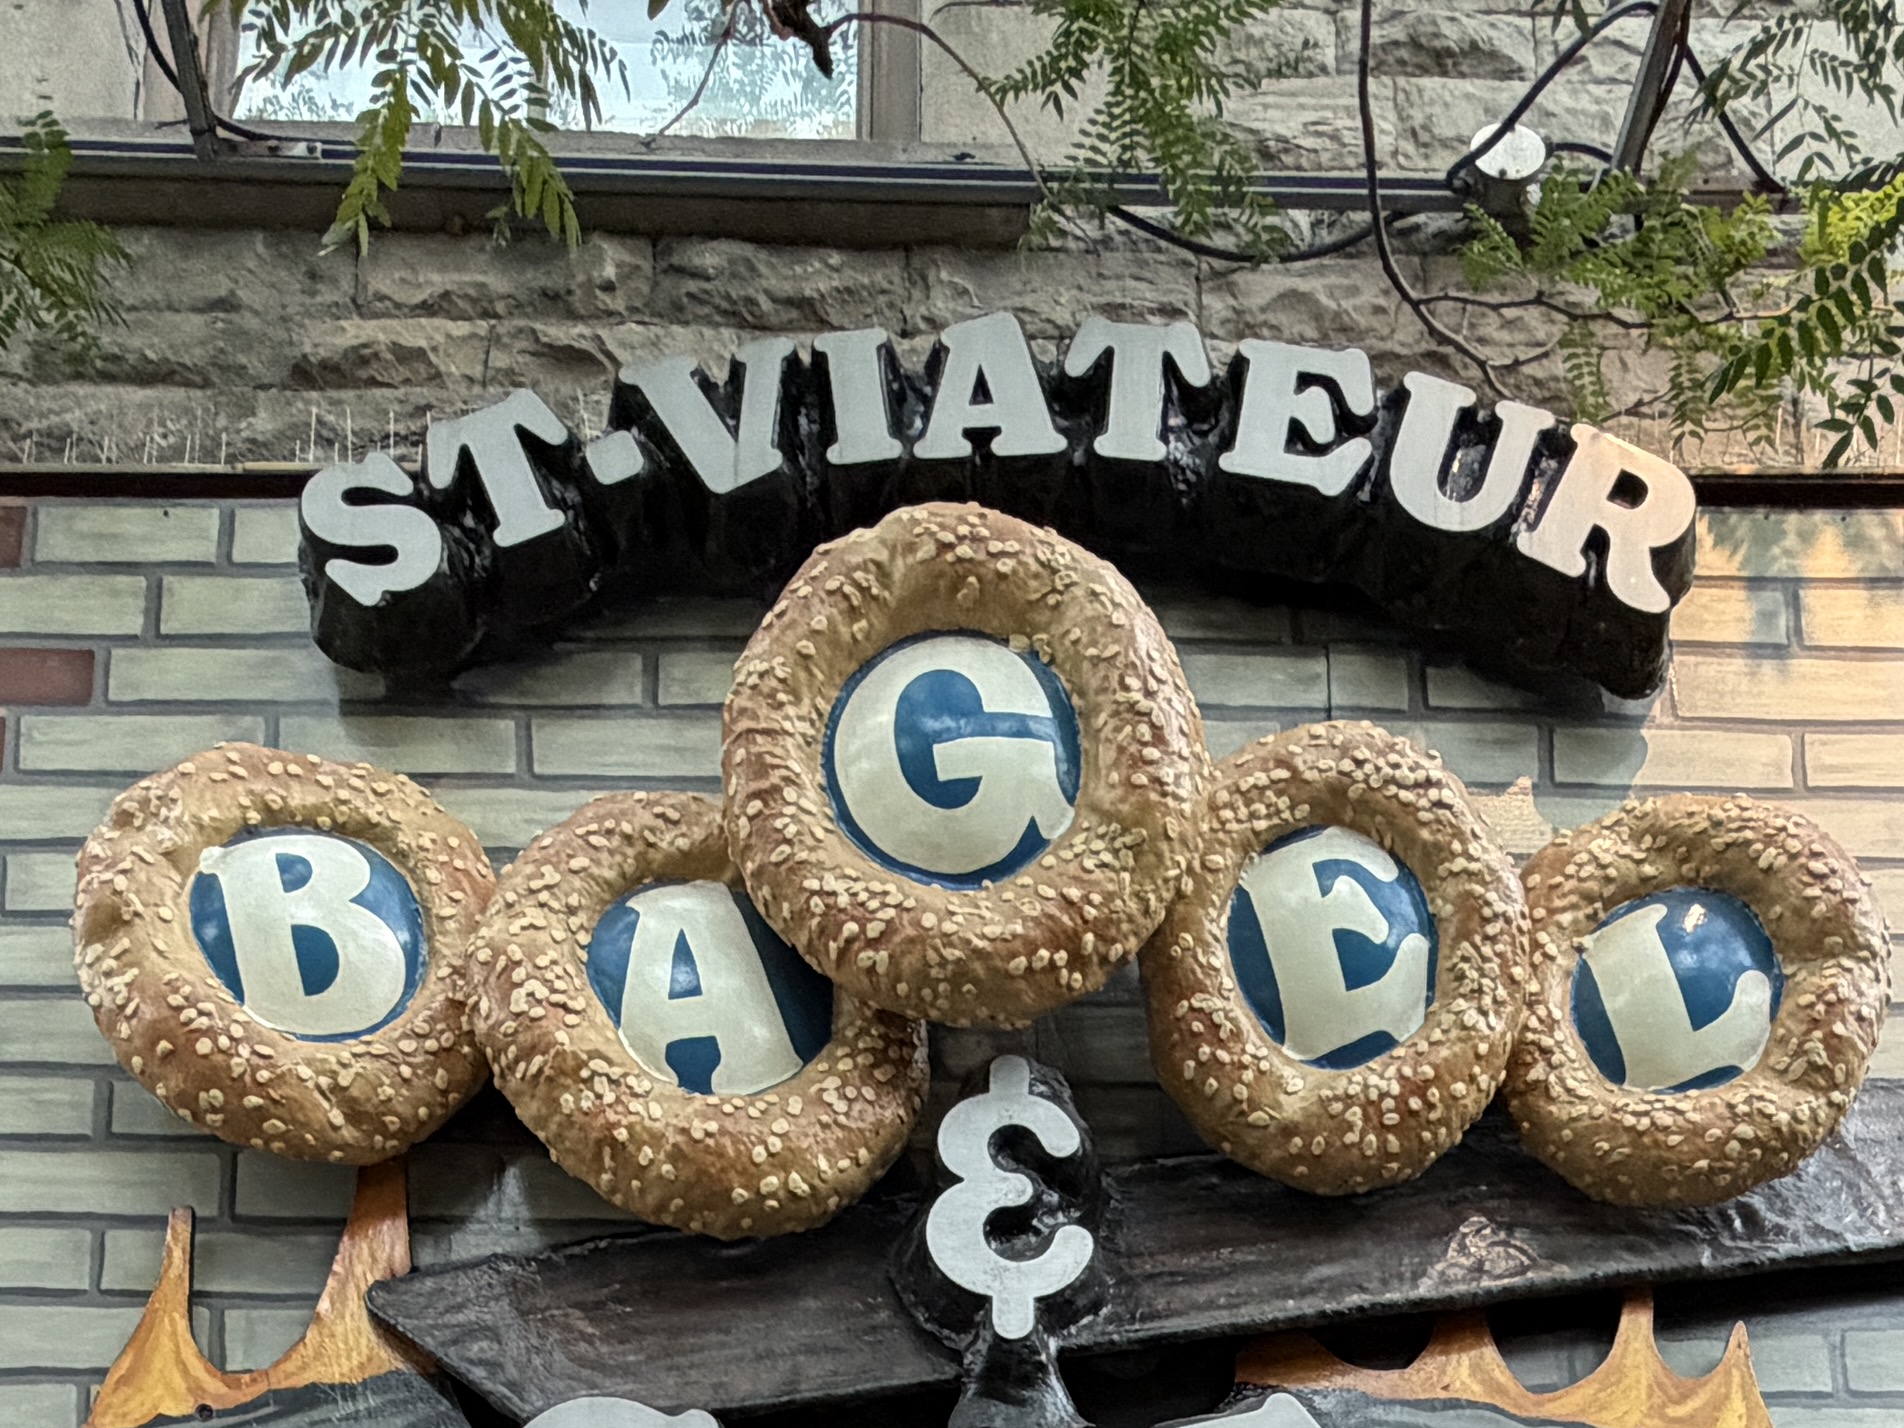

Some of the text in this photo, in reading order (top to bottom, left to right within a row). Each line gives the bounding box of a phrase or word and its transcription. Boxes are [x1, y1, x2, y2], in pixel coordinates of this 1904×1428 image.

[301, 310, 1698, 614] ST-VIATEUR
[199, 634, 1782, 1095] BAGEL
[925, 1054, 1094, 1339] &
